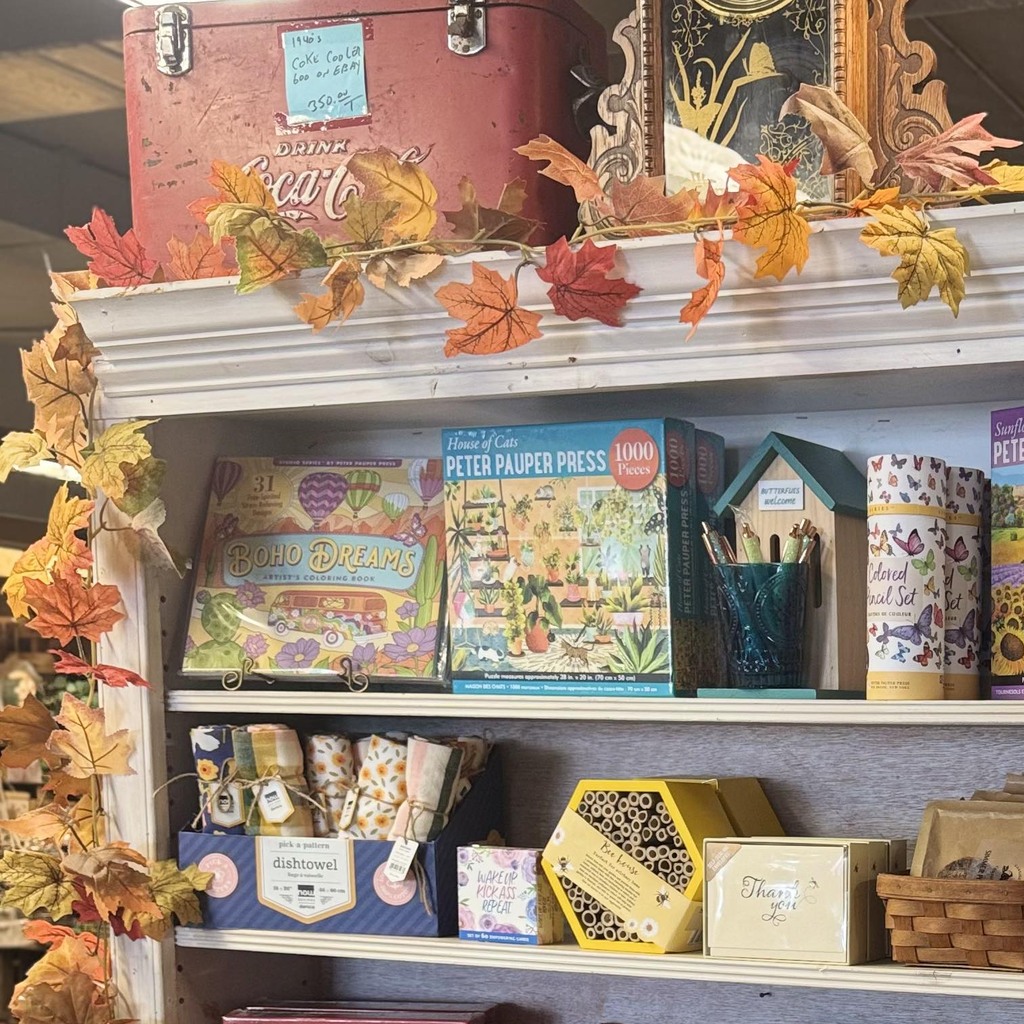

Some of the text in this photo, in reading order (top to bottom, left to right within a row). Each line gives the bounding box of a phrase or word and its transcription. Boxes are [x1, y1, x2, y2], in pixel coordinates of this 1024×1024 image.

[293, 72, 309, 85] 600
[333, 62, 361, 76] EBAY
[274, 139, 349, 157] DRINK
[448, 435, 518, 453] House of Cats
[614, 440, 654, 462] 1000
[446, 450, 607, 477] PETER PAUPER PRESS
[618, 464, 650, 476] Pieces
[254, 475, 275, 493] 31
[764, 496, 796, 506] welcome
[228, 537, 416, 578] BOHO DREAMS
[303, 574, 348, 582] COLORING
[868, 561, 908, 584] Colored
[273, 857, 337, 870] dishtowel
[600, 840, 638, 876] Bee house
[477, 870, 518, 886] WAKE UP
[477, 885, 516, 899] KICK ASS
[741, 876, 800, 900] Thank
[482, 900, 512, 914] REPEAT
[762, 900, 797, 926] you
